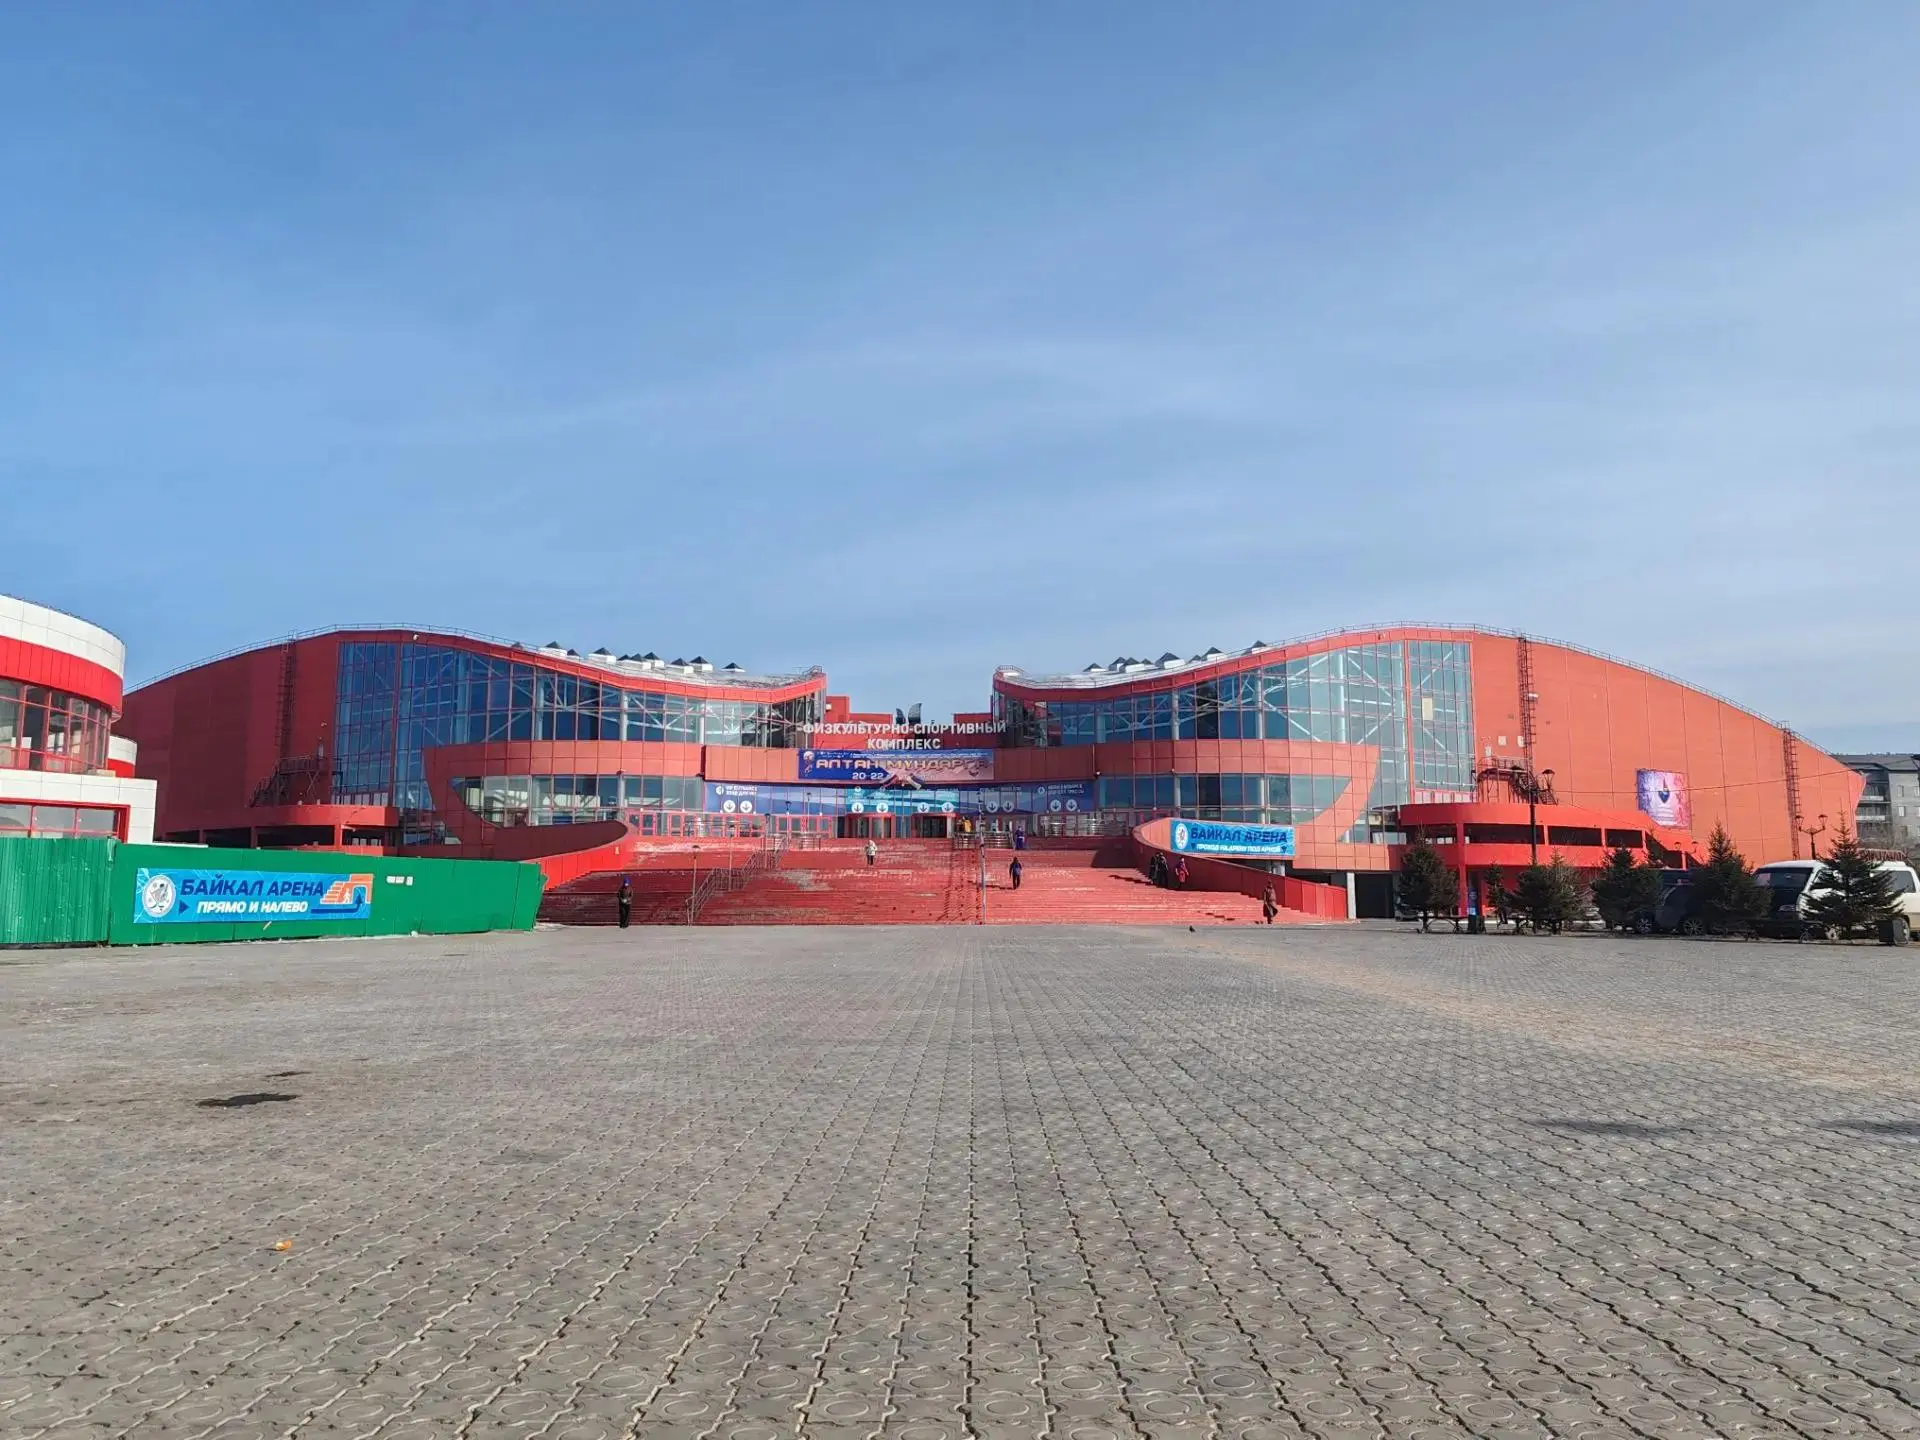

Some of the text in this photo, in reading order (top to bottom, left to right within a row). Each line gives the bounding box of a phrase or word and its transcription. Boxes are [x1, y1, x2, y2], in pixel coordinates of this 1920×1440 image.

[802, 720, 1006, 735] ФИЗКУЛЬТУРНО-СПОРТИВНЫЙ
[867, 738, 942, 750] КОМПЛЕКС
[1191, 825, 1240, 841] БАЙКАЛ
[180, 873, 325, 896] БАЙКАЛ АРЕНА
[196, 900, 309, 914] ПРЯМО И НАЛЕВО
